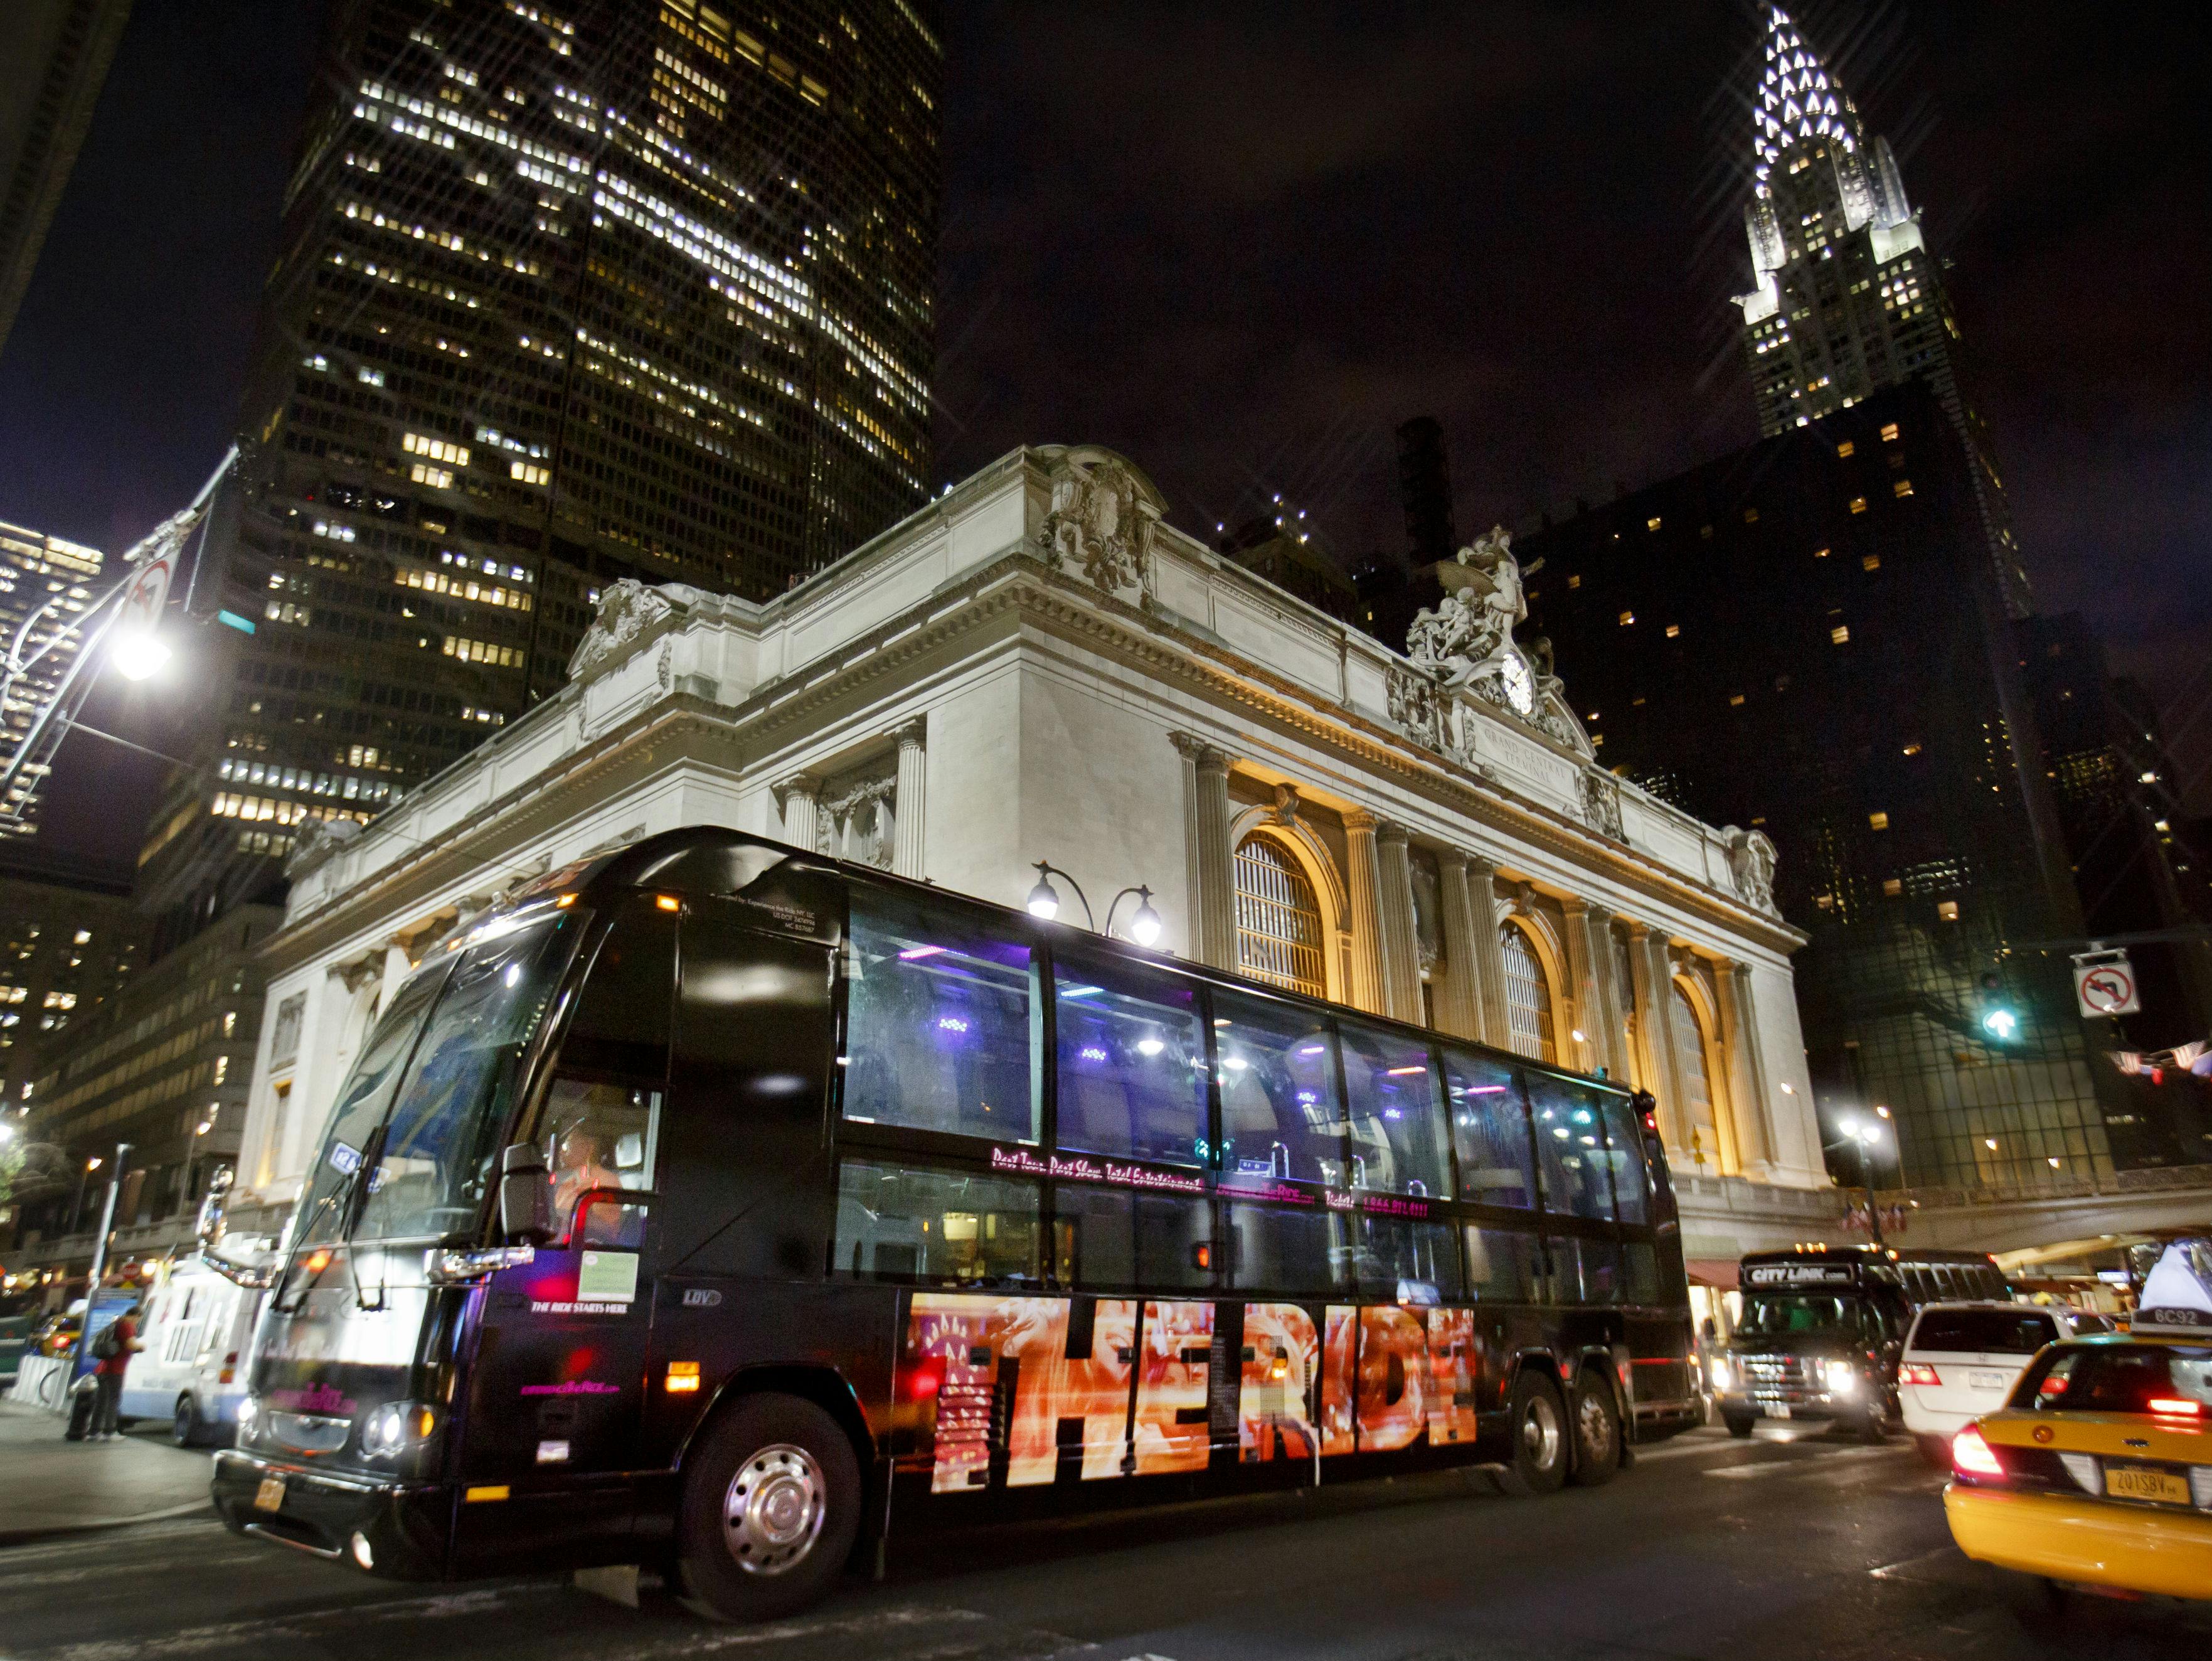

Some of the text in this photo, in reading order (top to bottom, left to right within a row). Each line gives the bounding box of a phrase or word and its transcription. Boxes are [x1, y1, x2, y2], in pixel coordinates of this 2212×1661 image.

[1484, 728, 1565, 779] GRAND CENTRAL
[1505, 750, 1551, 784] TERMINAL
[1106, 1163, 1131, 1182] Total
[531, 1302, 628, 1314] THE RIDE STARTS HERE
